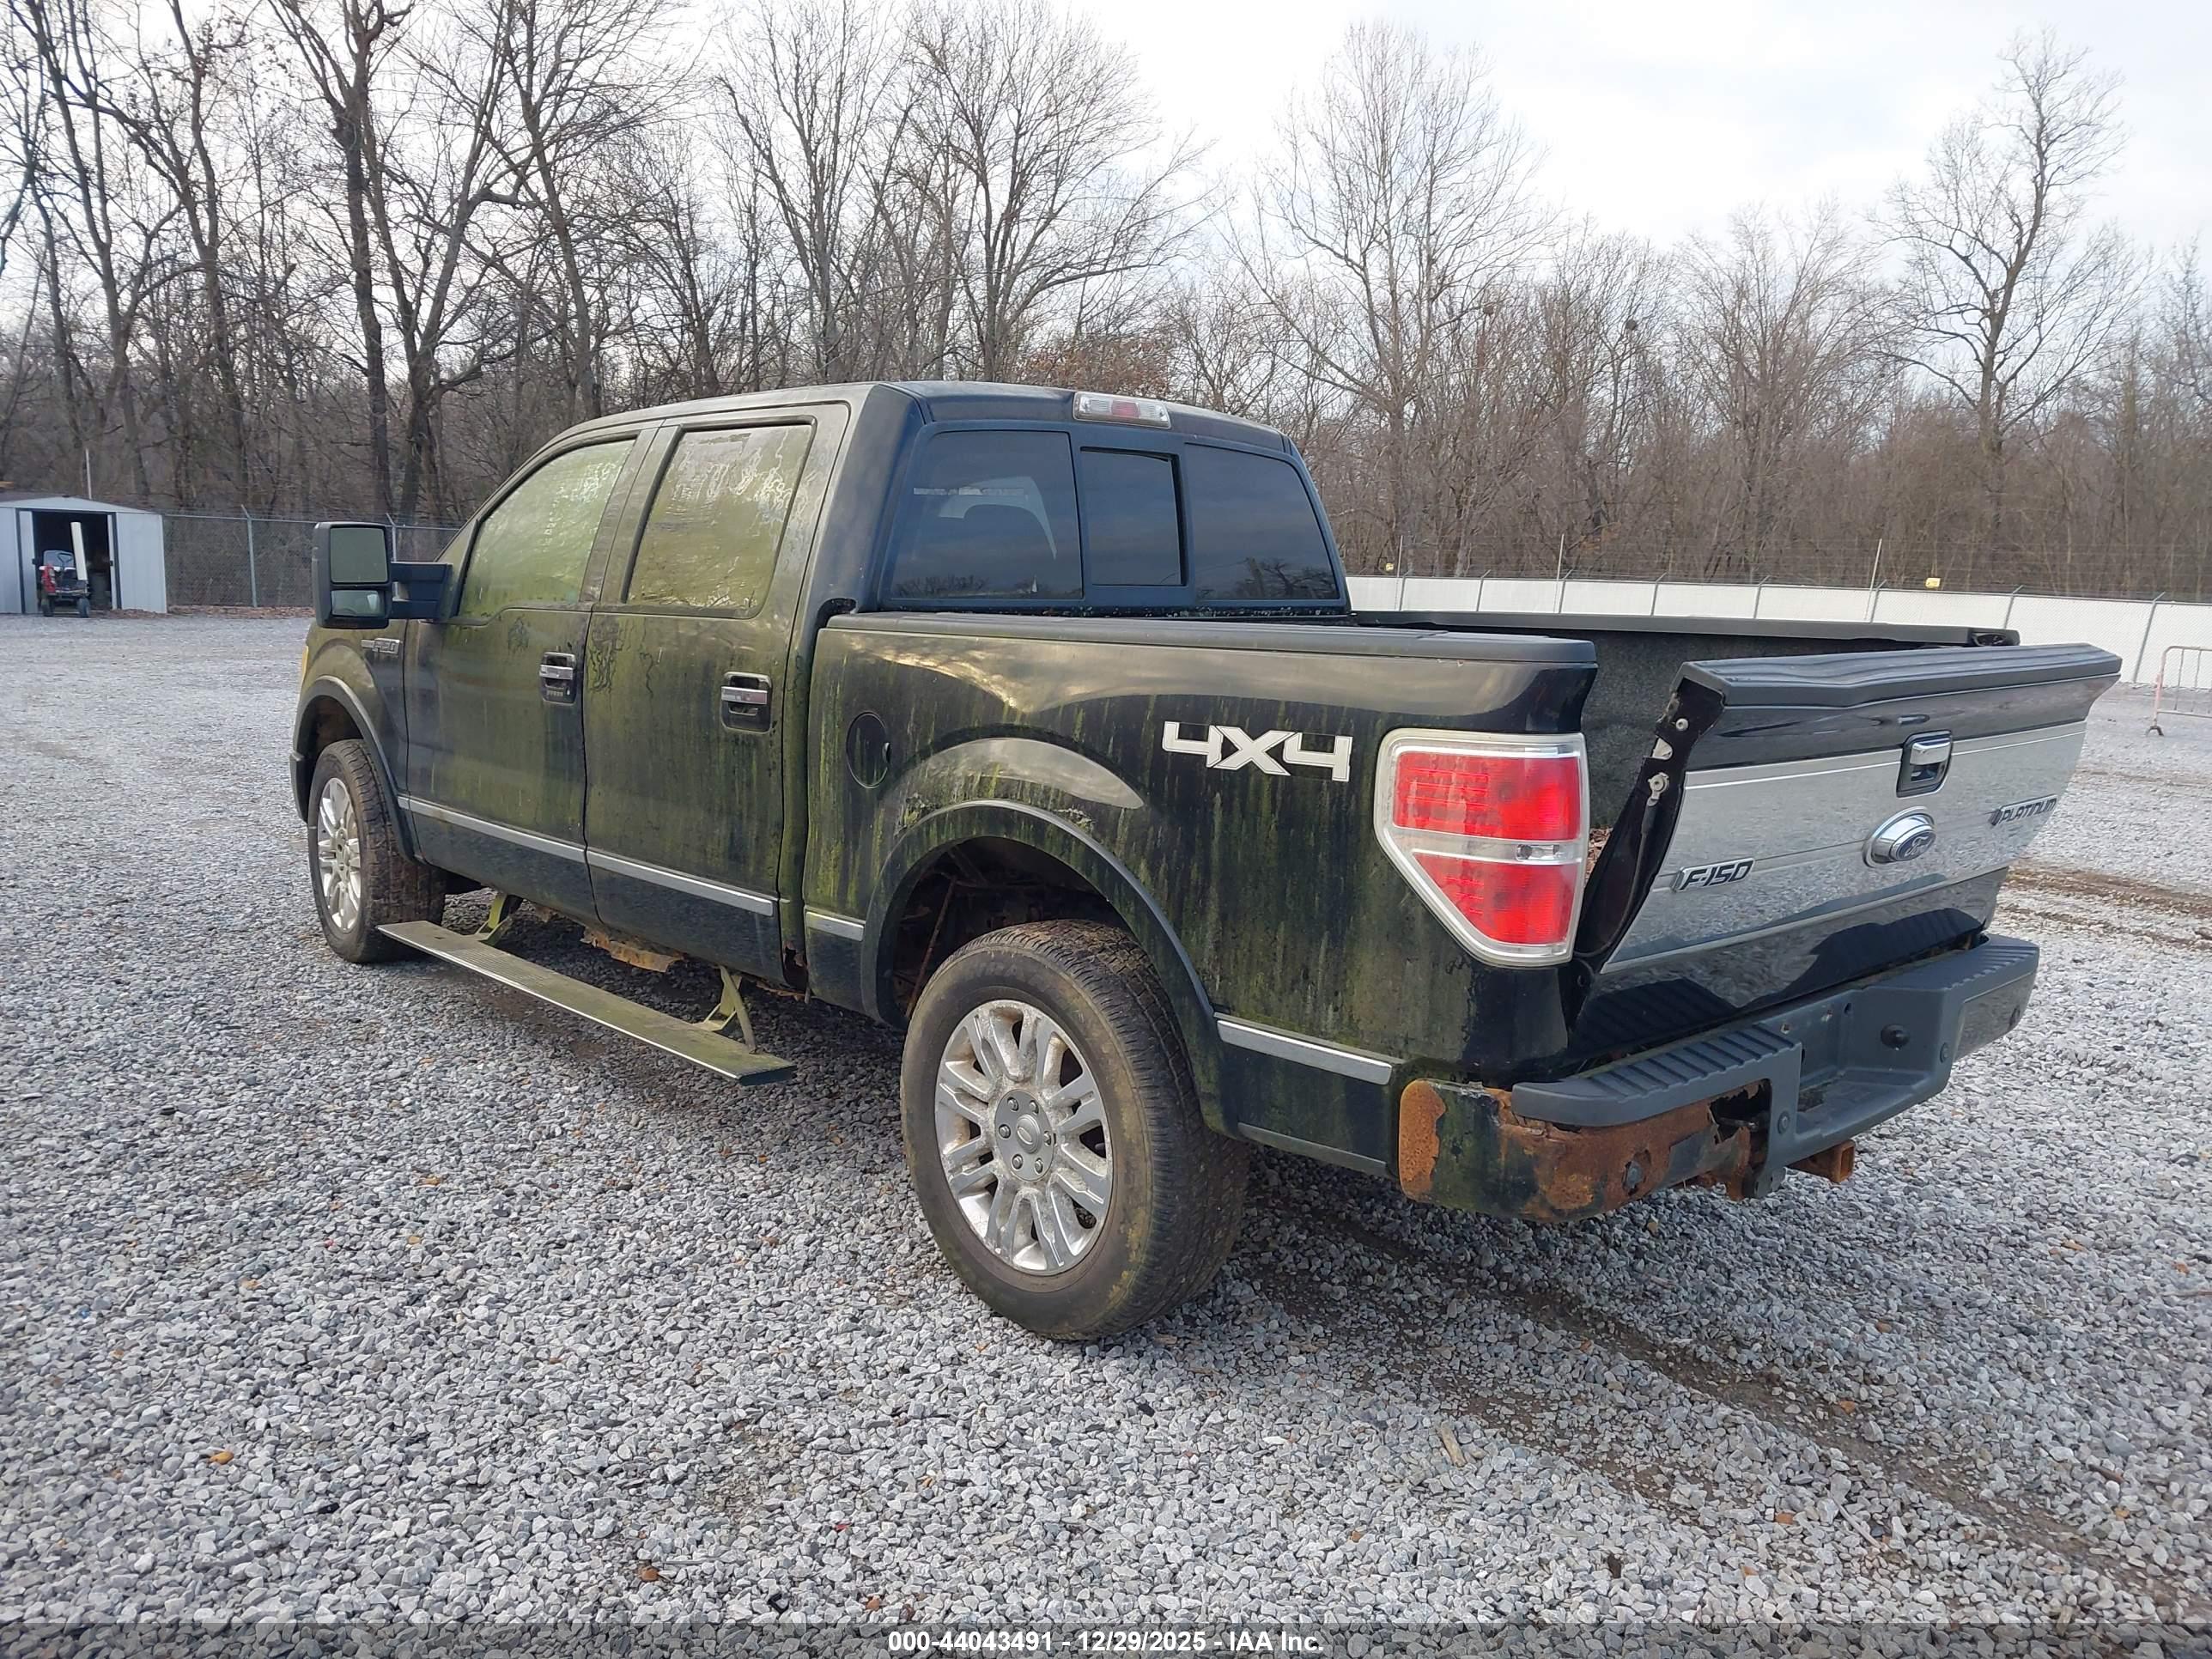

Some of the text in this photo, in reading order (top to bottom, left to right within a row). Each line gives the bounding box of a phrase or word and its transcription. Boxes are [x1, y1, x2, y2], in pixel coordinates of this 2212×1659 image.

[1162, 720, 1353, 782] 4X4
[1997, 797, 2057, 824] PLATINUM
[1679, 860, 1754, 890] F-150
